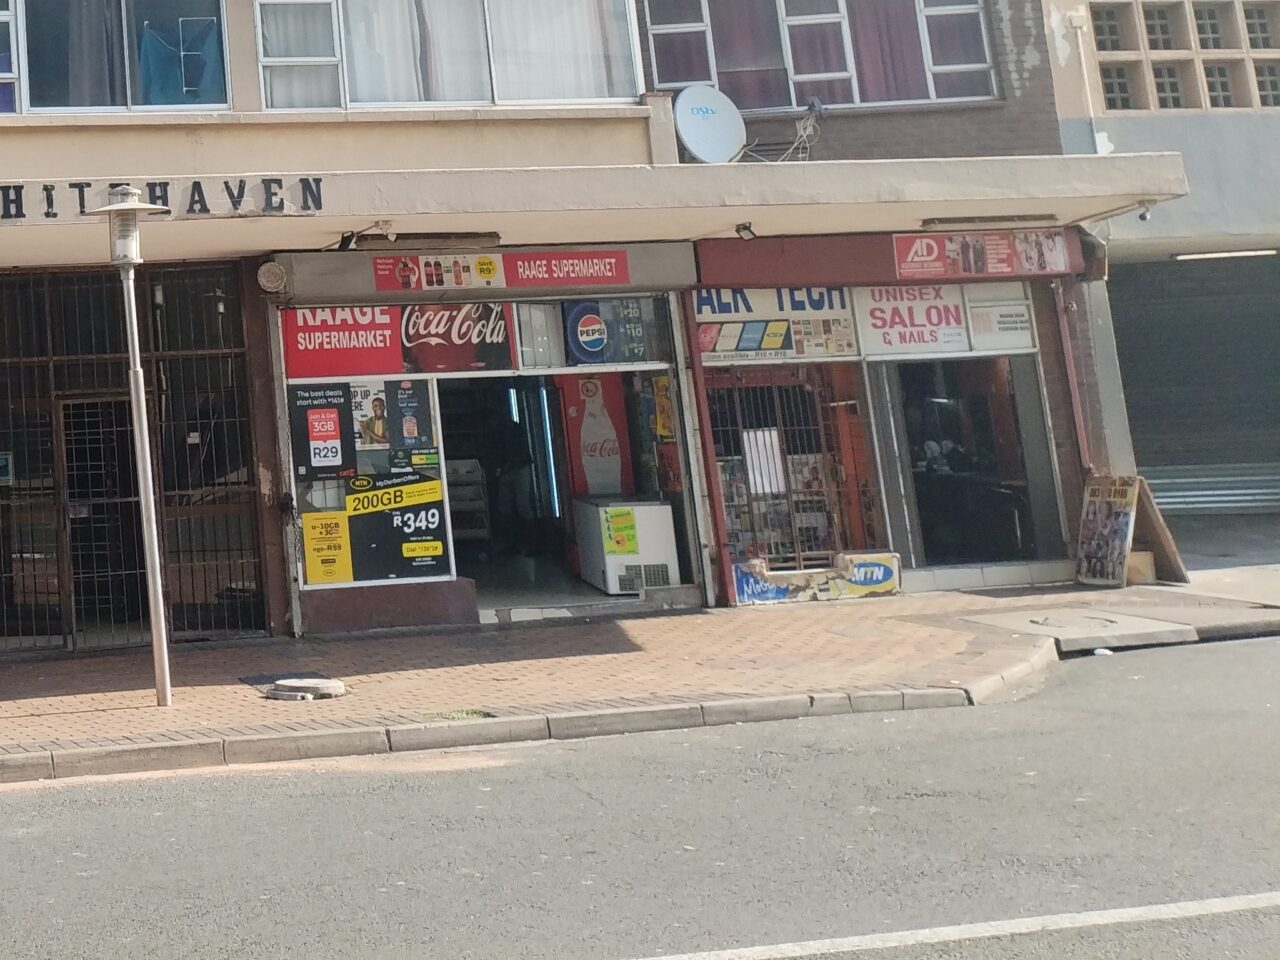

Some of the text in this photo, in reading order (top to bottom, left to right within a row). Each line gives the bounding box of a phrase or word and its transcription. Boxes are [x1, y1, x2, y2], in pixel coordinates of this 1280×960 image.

[517, 258, 616, 279] RAAGE SUPERMARKET
[871, 286, 944, 303] UNISEX
[401, 303, 506, 348] Coca-Cola
[869, 304, 962, 330] SALON
[297, 330, 392, 350] SUPERMARKET
[579, 328, 606, 337] PEPSI
[882, 330, 938, 346] & NAILS
[310, 390, 324, 398] best
[325, 389, 343, 397] deals
[360, 389, 371, 400] UP
[313, 421, 335, 432] 3GB
[313, 446, 338, 459] R29
[352, 489, 404, 512] 200GB
[851, 565, 884, 582] MTN
